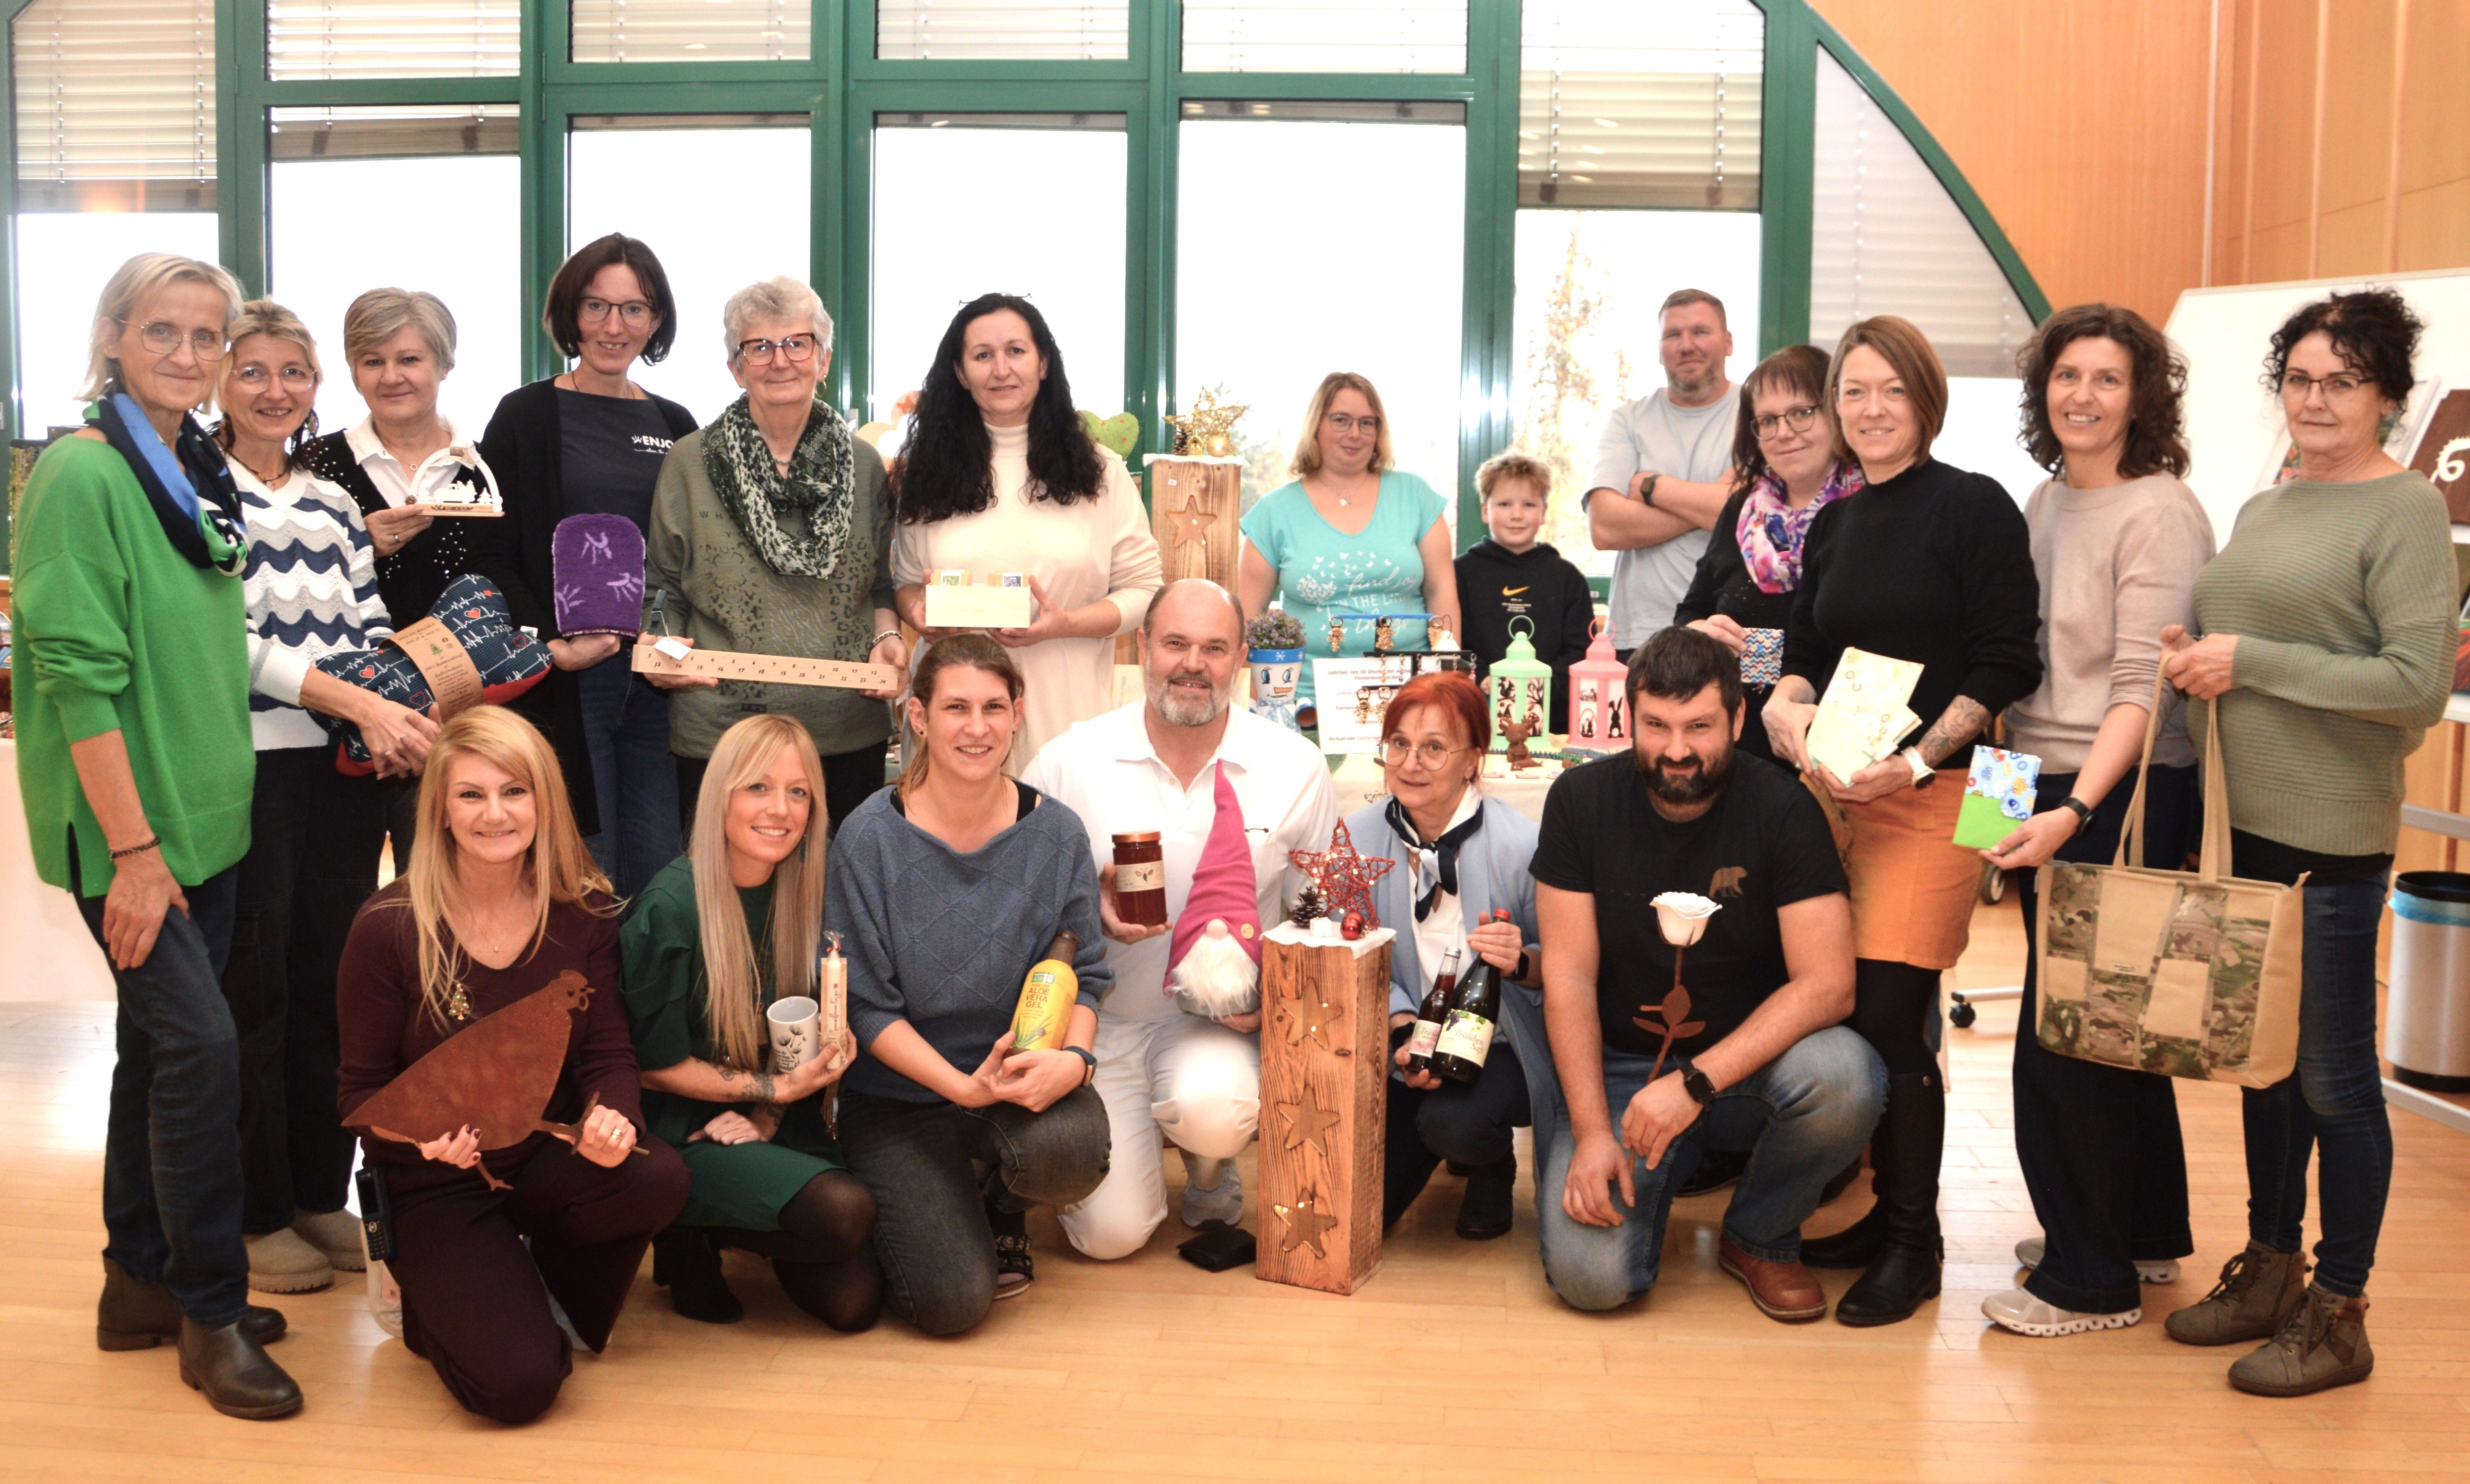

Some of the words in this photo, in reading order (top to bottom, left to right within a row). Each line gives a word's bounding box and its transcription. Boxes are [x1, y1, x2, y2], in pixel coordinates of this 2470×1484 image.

[642, 435, 673, 448] ENJO
[1345, 566, 1400, 596] find
[1385, 577, 1416, 594] joy
[1352, 594, 1378, 607] THE
[1028, 987, 1050, 996] ALOE
[1026, 994, 1047, 1003] VERA
[1455, 1029, 1484, 1046] Trauben
[1469, 1042, 1485, 1055] Saft
